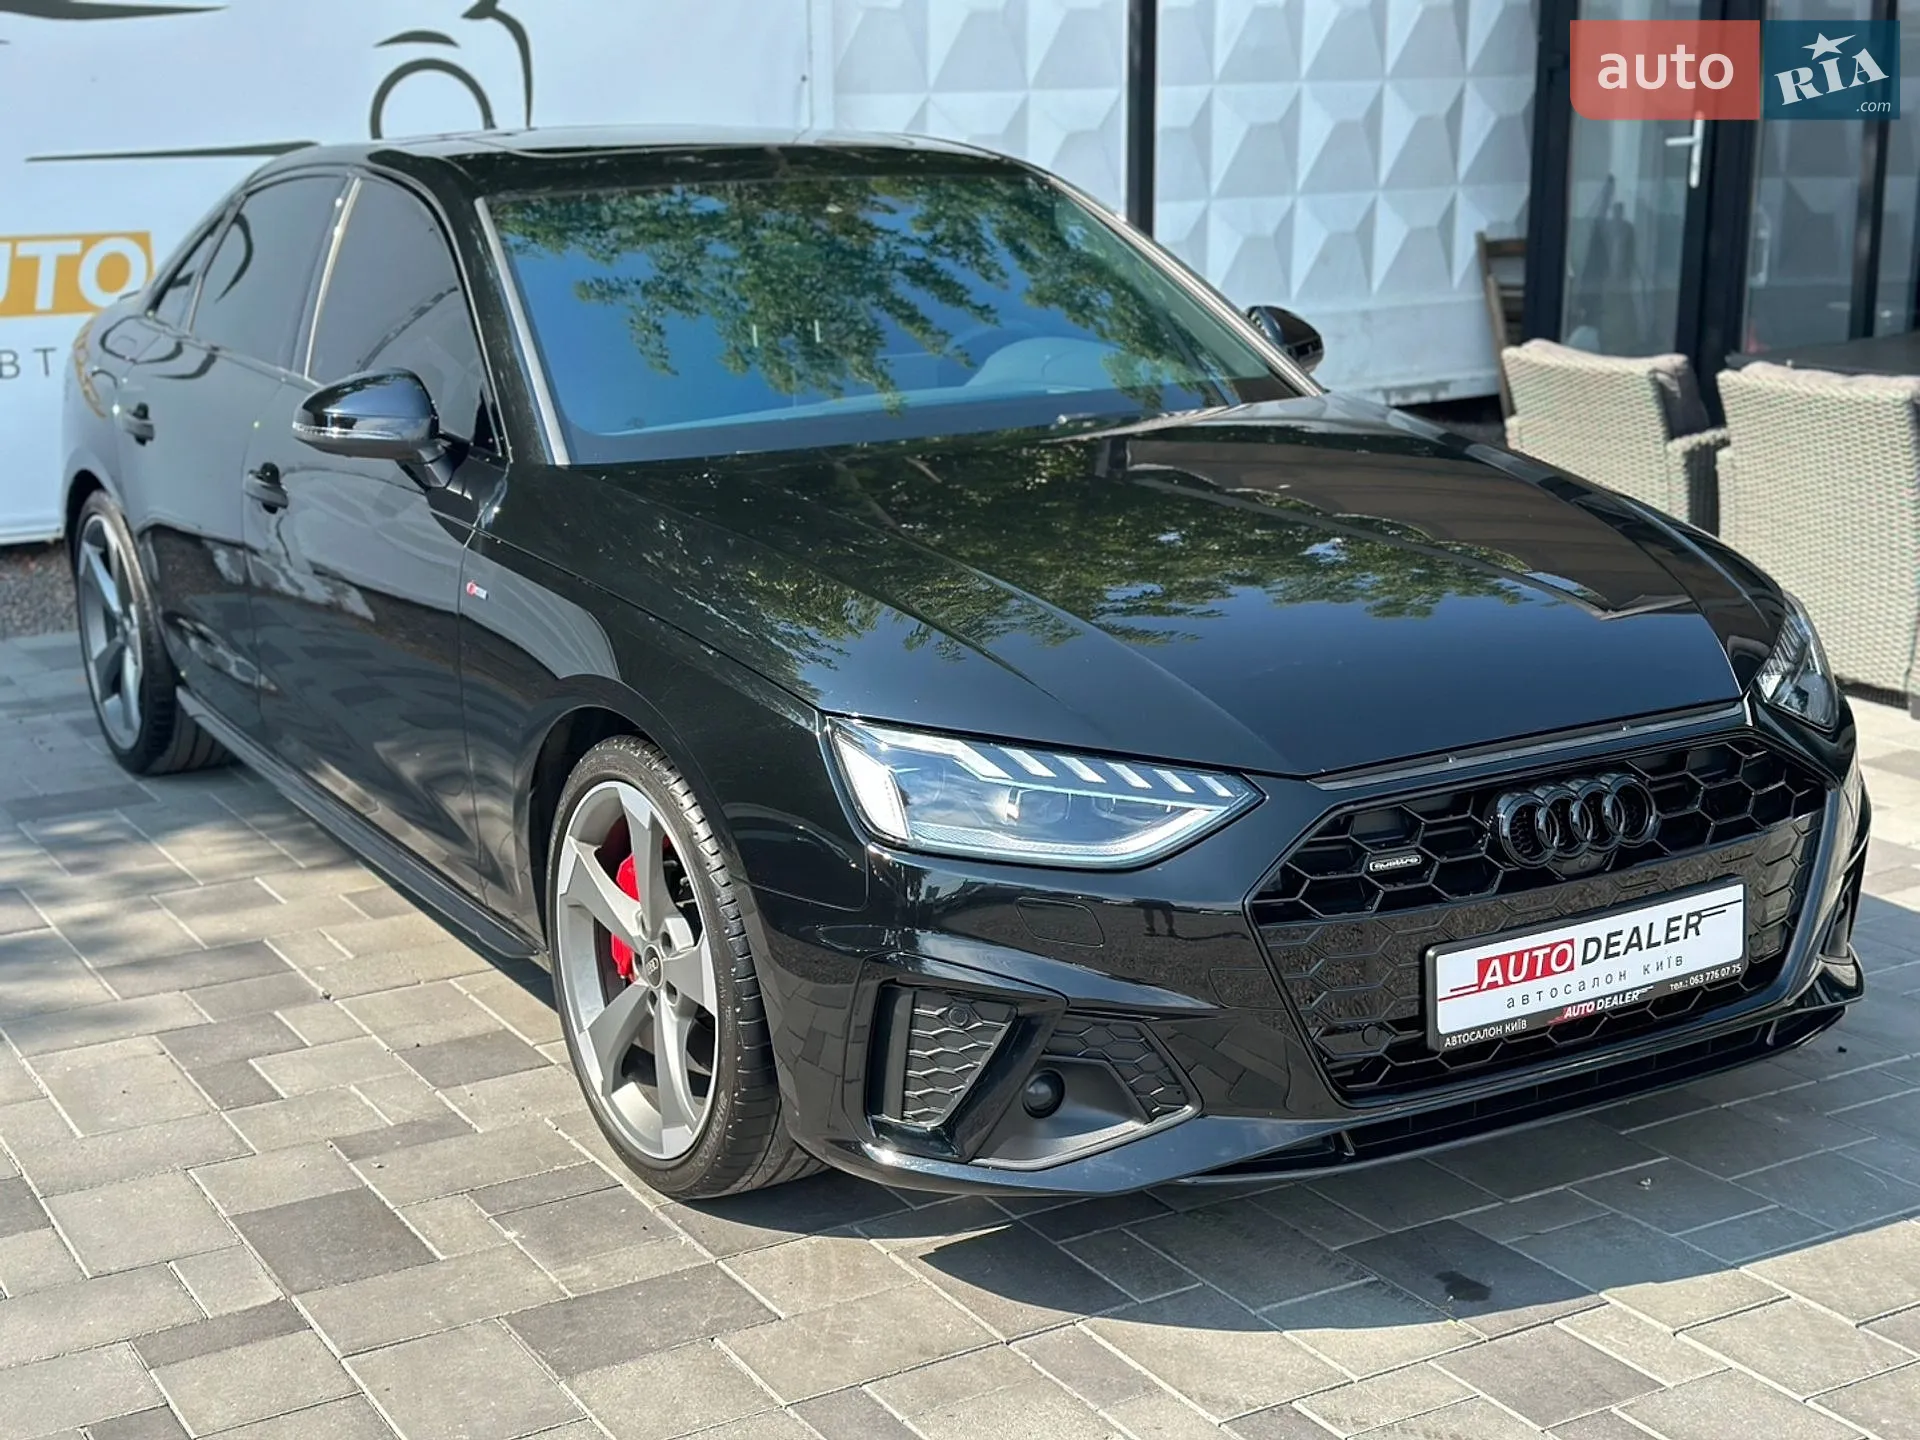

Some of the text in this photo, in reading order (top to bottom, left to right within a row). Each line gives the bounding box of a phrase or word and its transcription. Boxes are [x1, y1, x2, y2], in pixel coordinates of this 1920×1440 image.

[1479, 910, 1704, 989] AUTO DEALER
[1506, 954, 1684, 1010] автосалон київ
[1720, 966, 1731, 977] 07
[1731, 962, 1742, 974] 75
[1563, 989, 1640, 1019] AUTO DEALER
[1444, 1018, 1528, 1048] АВТОСАЛОН КИЇВ
